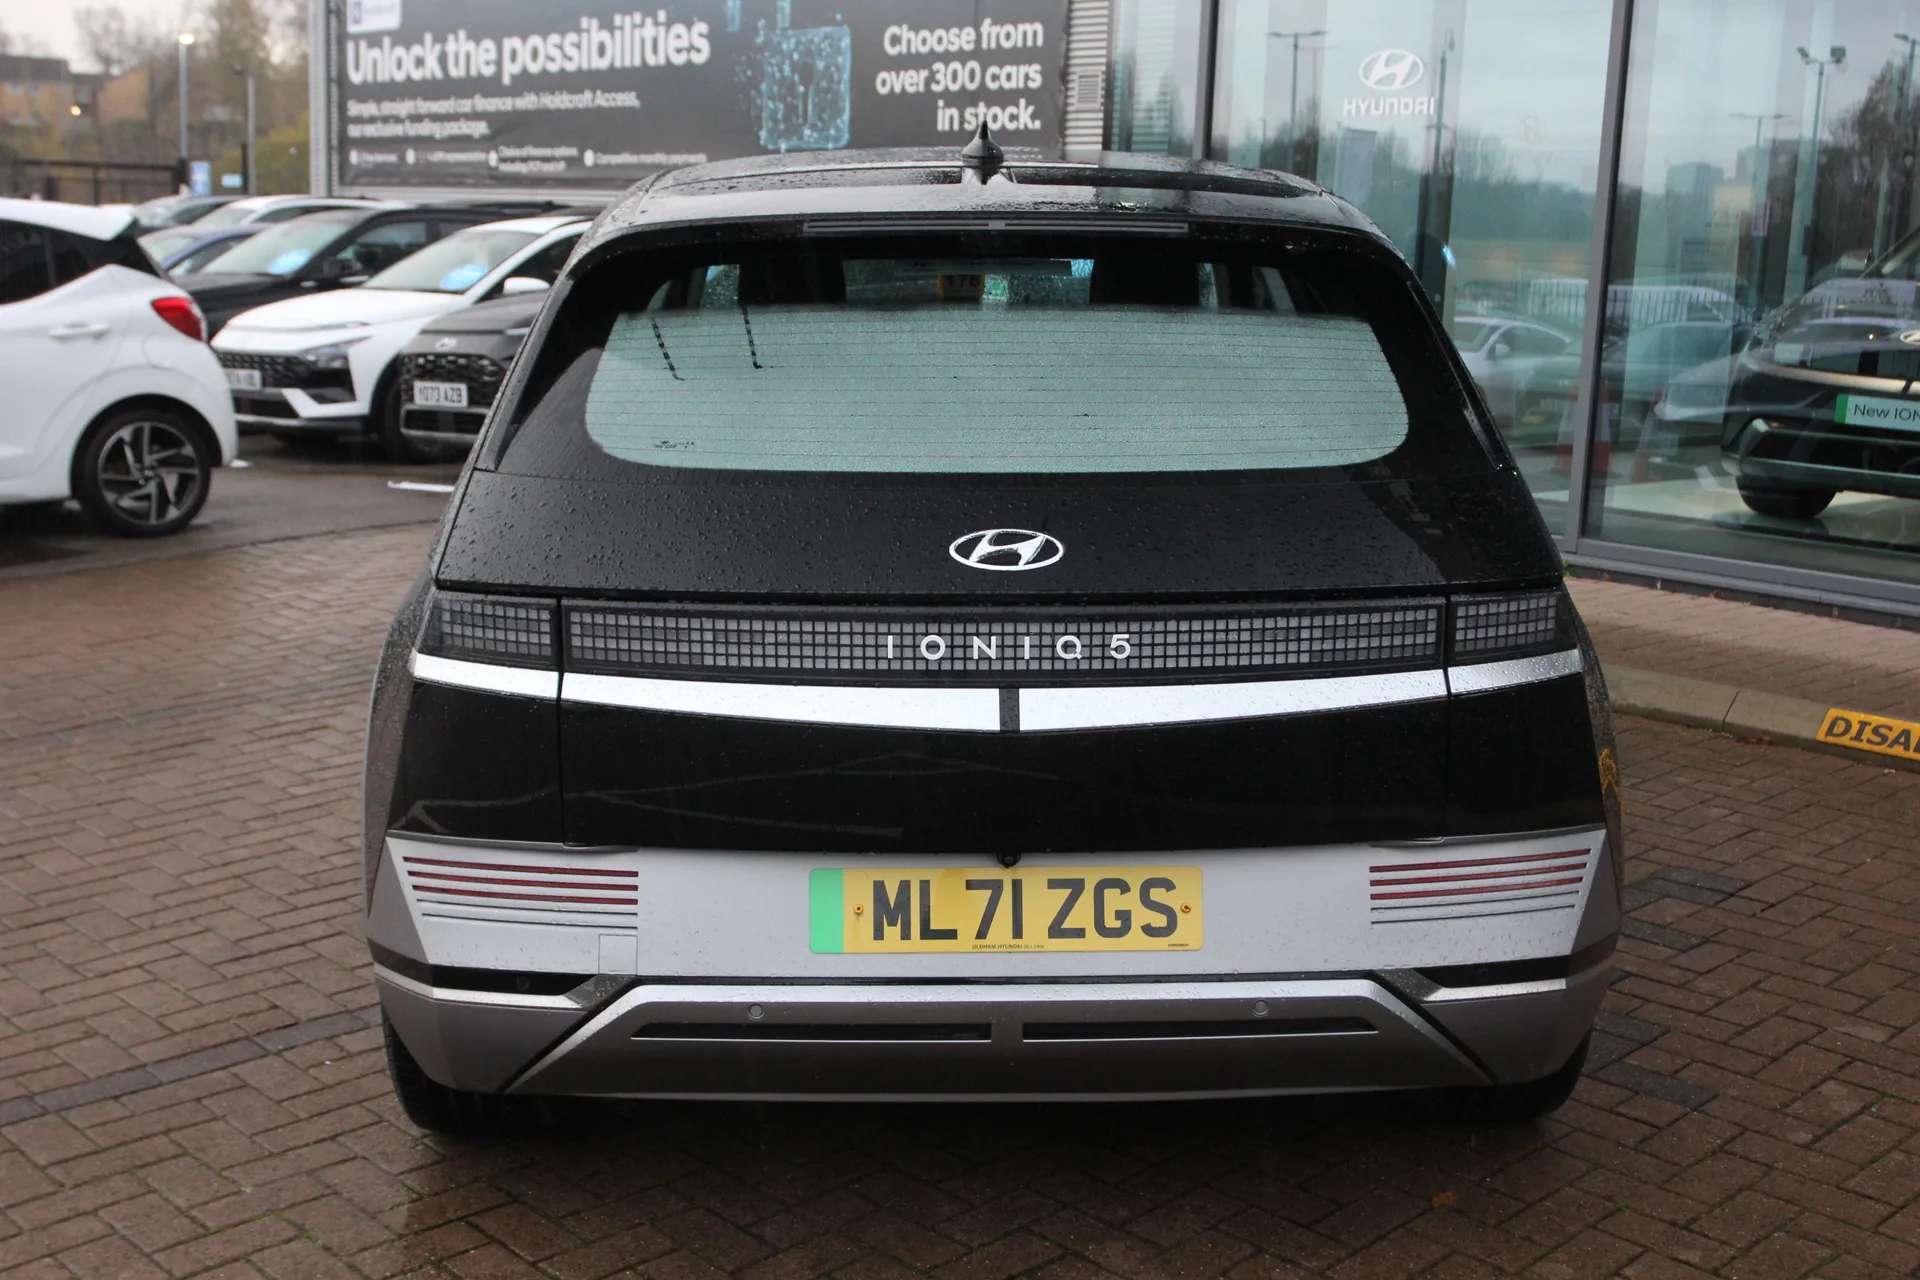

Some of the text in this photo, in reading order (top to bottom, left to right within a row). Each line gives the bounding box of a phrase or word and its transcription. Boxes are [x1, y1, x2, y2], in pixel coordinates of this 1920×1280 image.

[346, 10, 711, 85] Unlock the possibilities
[883, 18, 1044, 56] Choose from
[875, 61, 1042, 95] over 300 cars
[937, 98, 1041, 132] in stock.
[1343, 96, 1435, 116] HYUNDAI
[1854, 404, 1889, 418] New
[887, 633, 1131, 661] IONIQ 5
[872, 877, 1178, 941] ML71 ZGS
